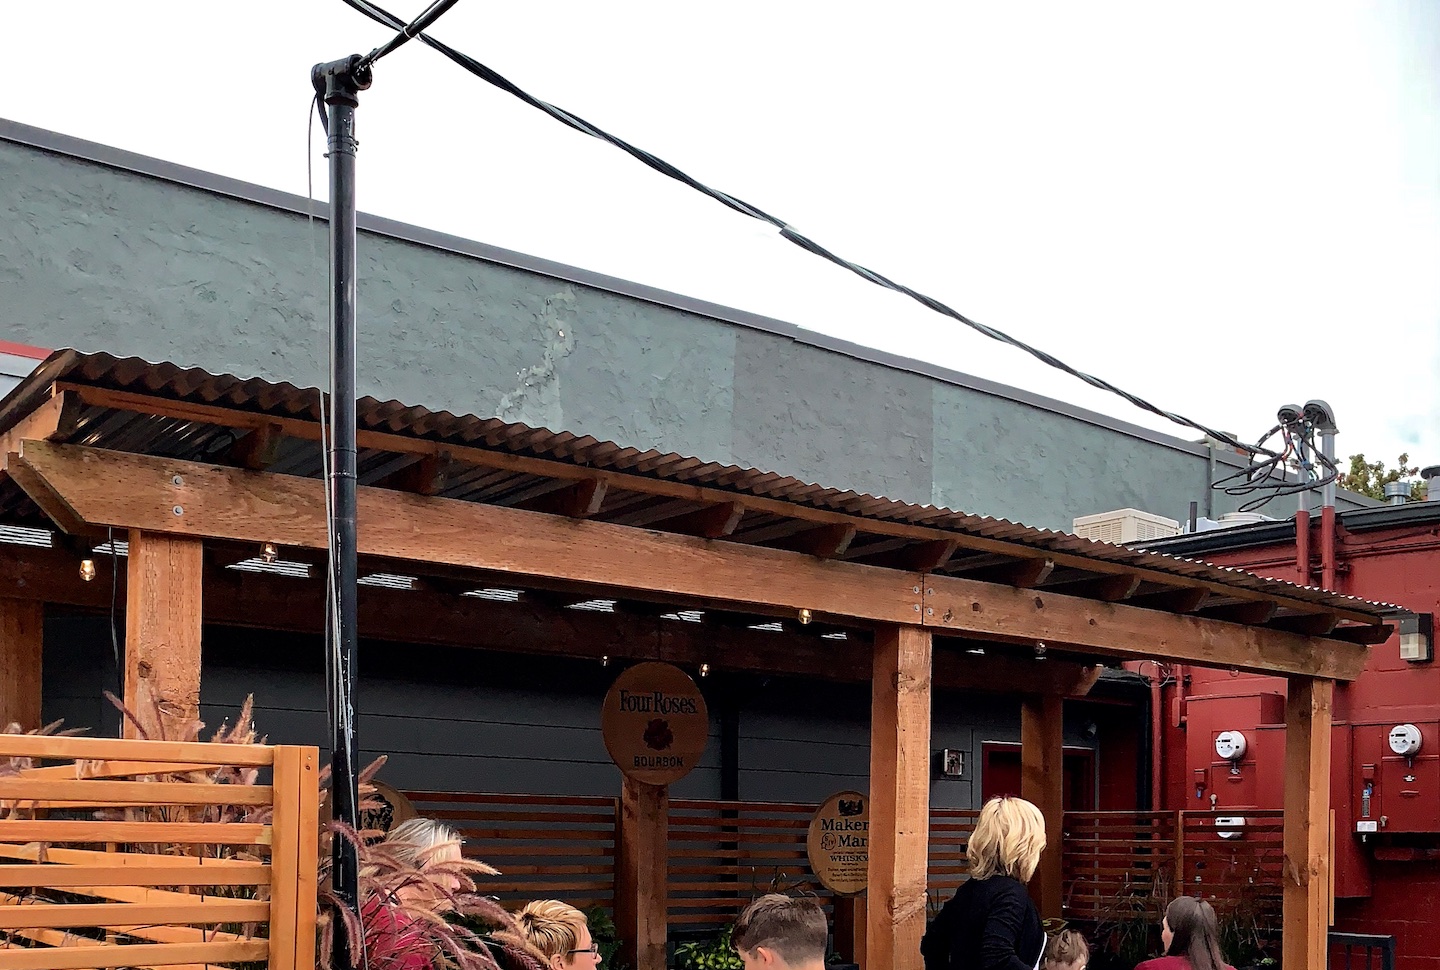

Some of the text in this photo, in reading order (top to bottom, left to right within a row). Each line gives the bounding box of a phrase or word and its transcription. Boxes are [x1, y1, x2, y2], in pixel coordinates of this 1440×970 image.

[620, 690, 697, 714] Four Roses
[633, 756, 684, 767] BOURBON
[821, 819, 869, 831] Maker
[838, 835, 869, 847] Mar
